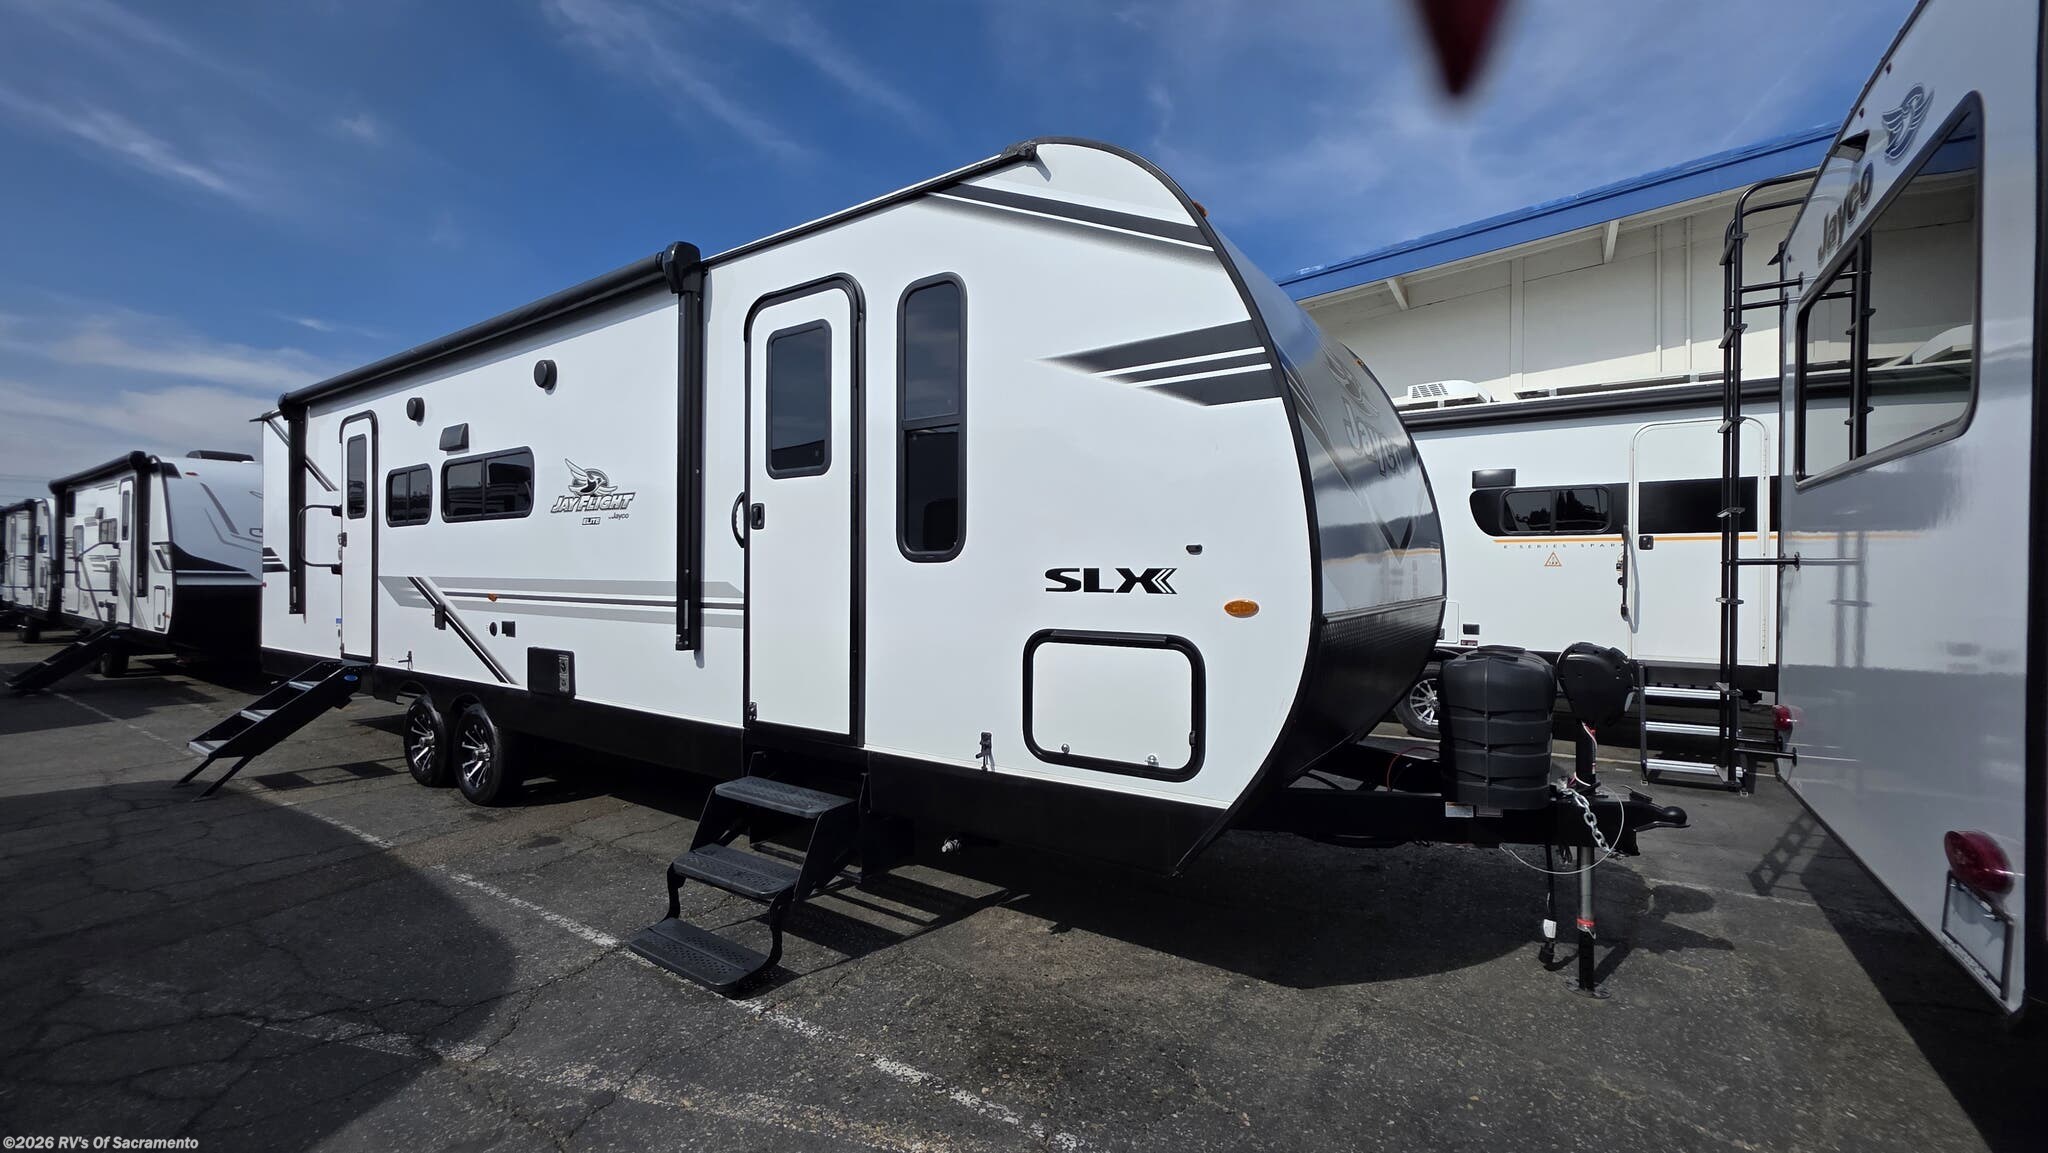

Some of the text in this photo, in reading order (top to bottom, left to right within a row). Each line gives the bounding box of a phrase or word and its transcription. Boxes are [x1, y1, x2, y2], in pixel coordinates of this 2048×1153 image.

[1817, 162, 1874, 267] Jayco
[550, 492, 636, 513] JAY FLIGHT
[582, 517, 601, 525] ELITE
[613, 512, 630, 520] Jayco
[1045, 567, 1178, 595] SLX
